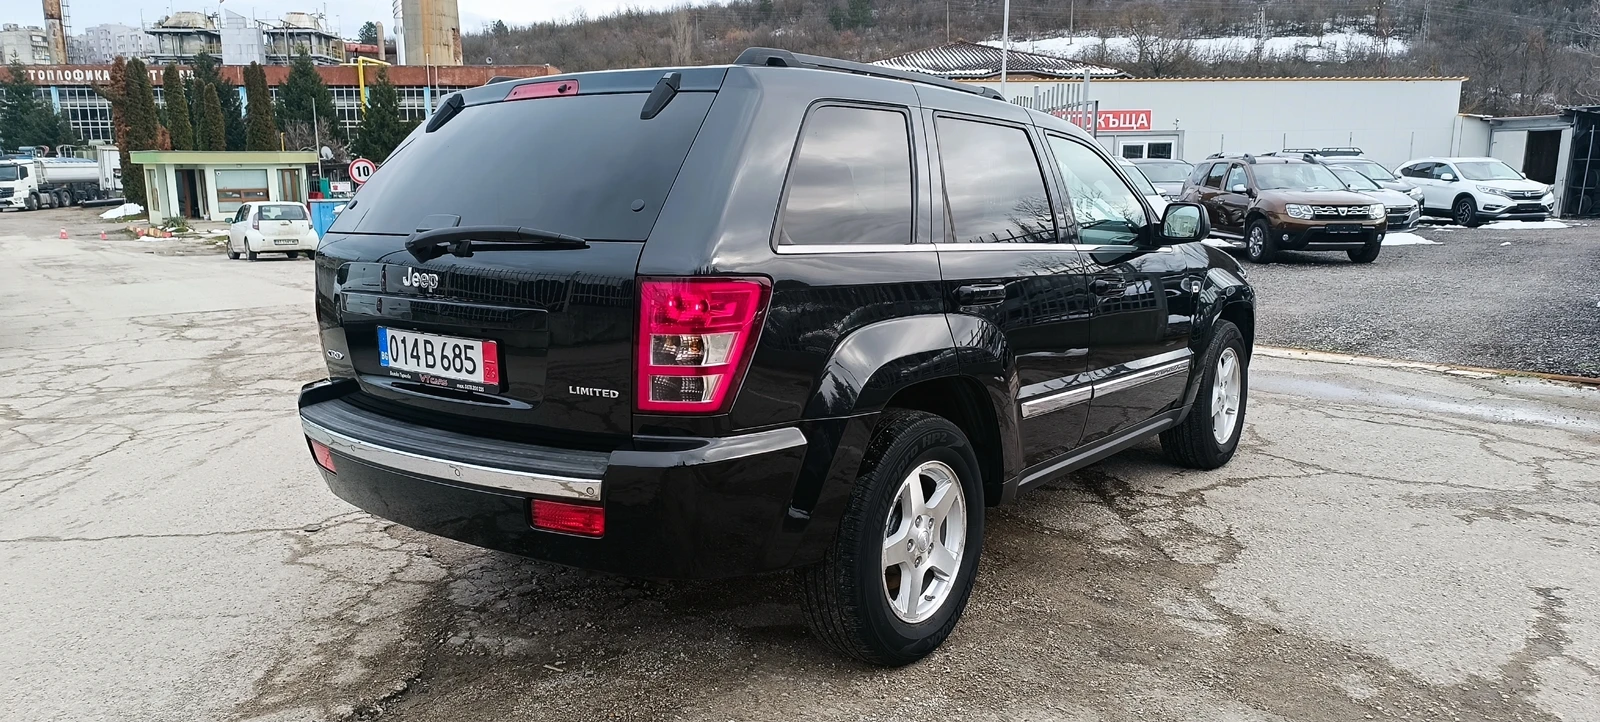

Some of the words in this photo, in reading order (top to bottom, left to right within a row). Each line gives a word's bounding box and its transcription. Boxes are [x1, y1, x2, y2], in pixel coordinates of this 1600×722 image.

[28, 69, 111, 82] ТОПЛОФИКА
[355, 165, 370, 178] 10
[402, 266, 439, 293] Jeep
[389, 334, 477, 375] 014B685
[568, 385, 620, 399] LIMITED
